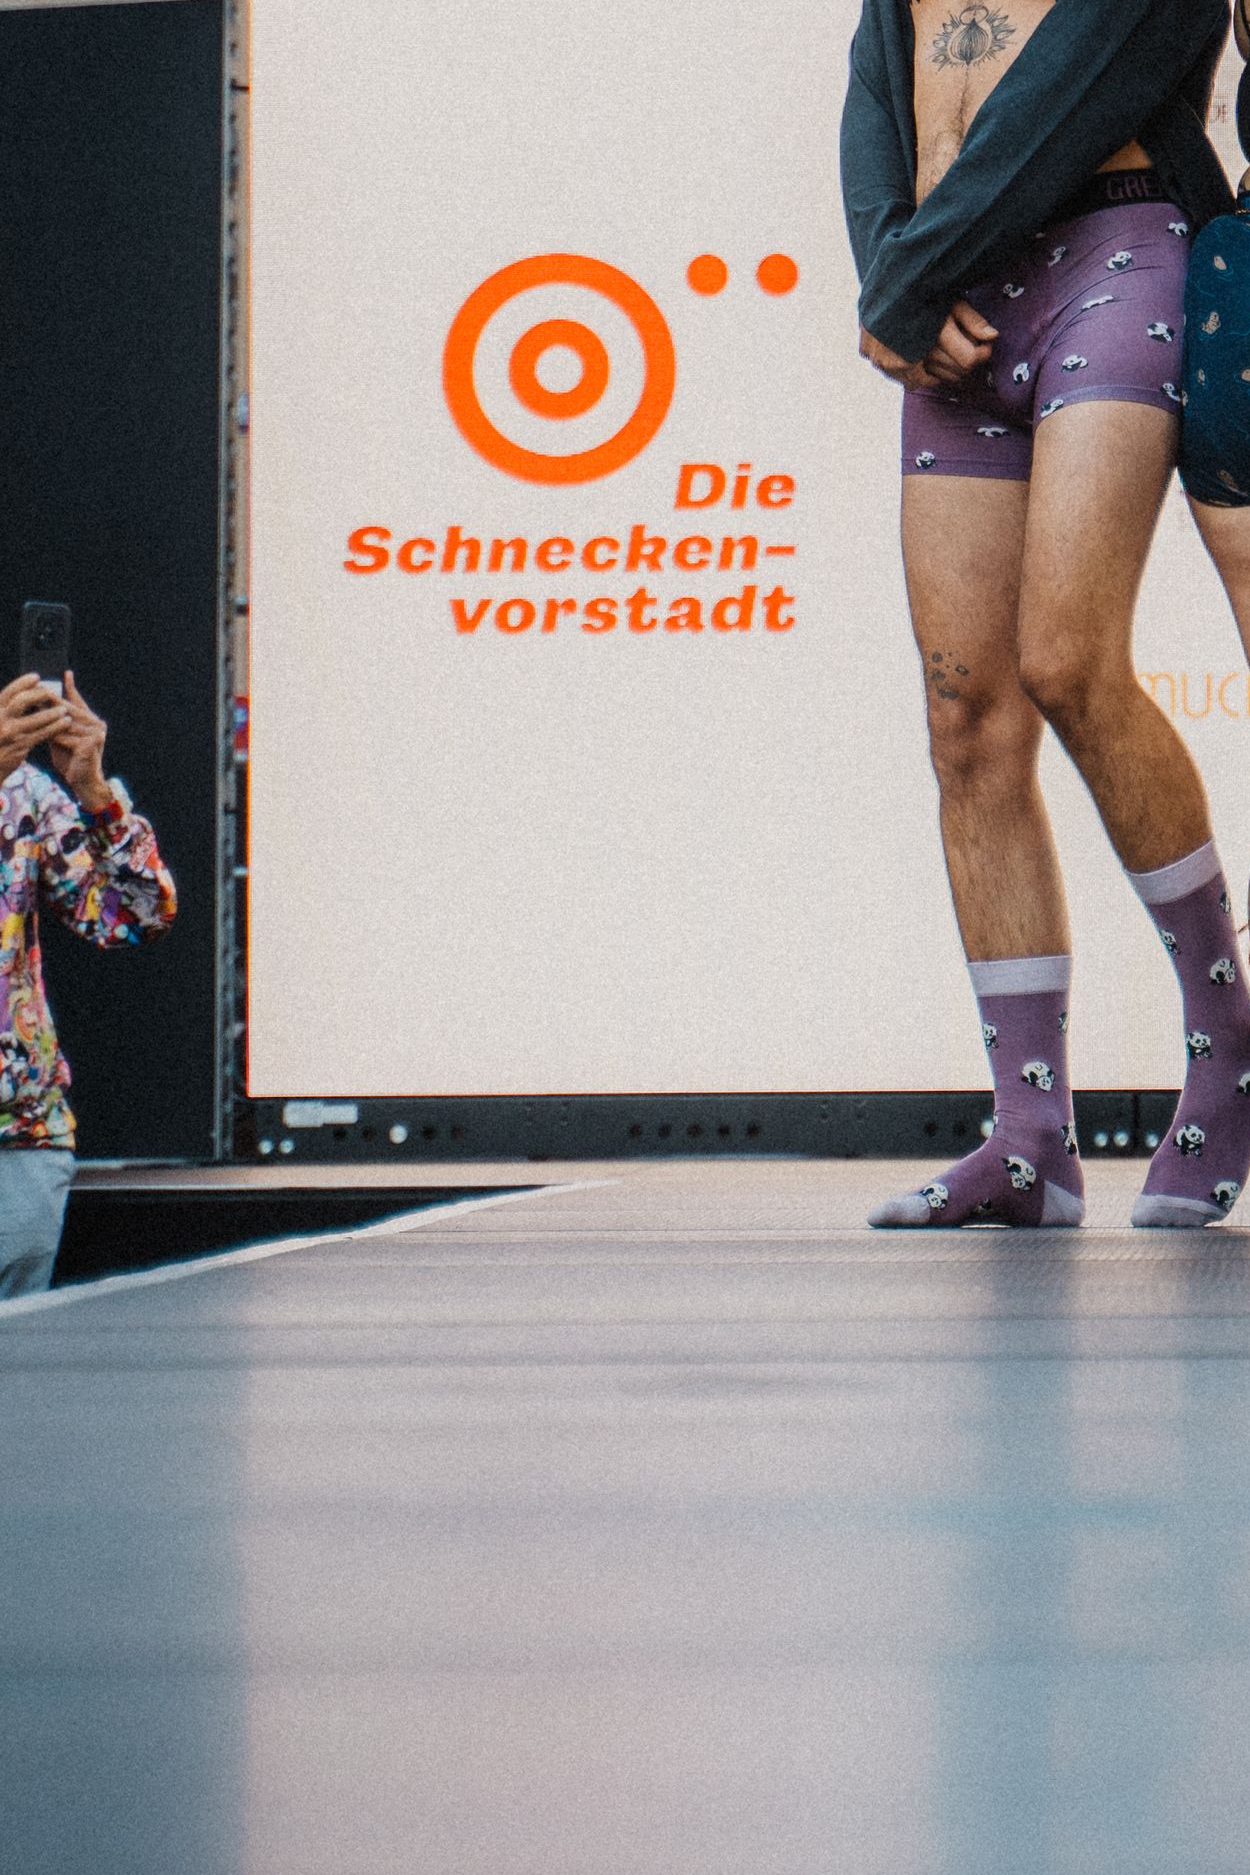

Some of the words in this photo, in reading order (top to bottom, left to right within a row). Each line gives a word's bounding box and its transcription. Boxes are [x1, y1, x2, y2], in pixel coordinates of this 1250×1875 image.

[675, 463, 796, 509] Die
[344, 524, 796, 575] Schnecken-
[450, 585, 796, 635] vorstadt
